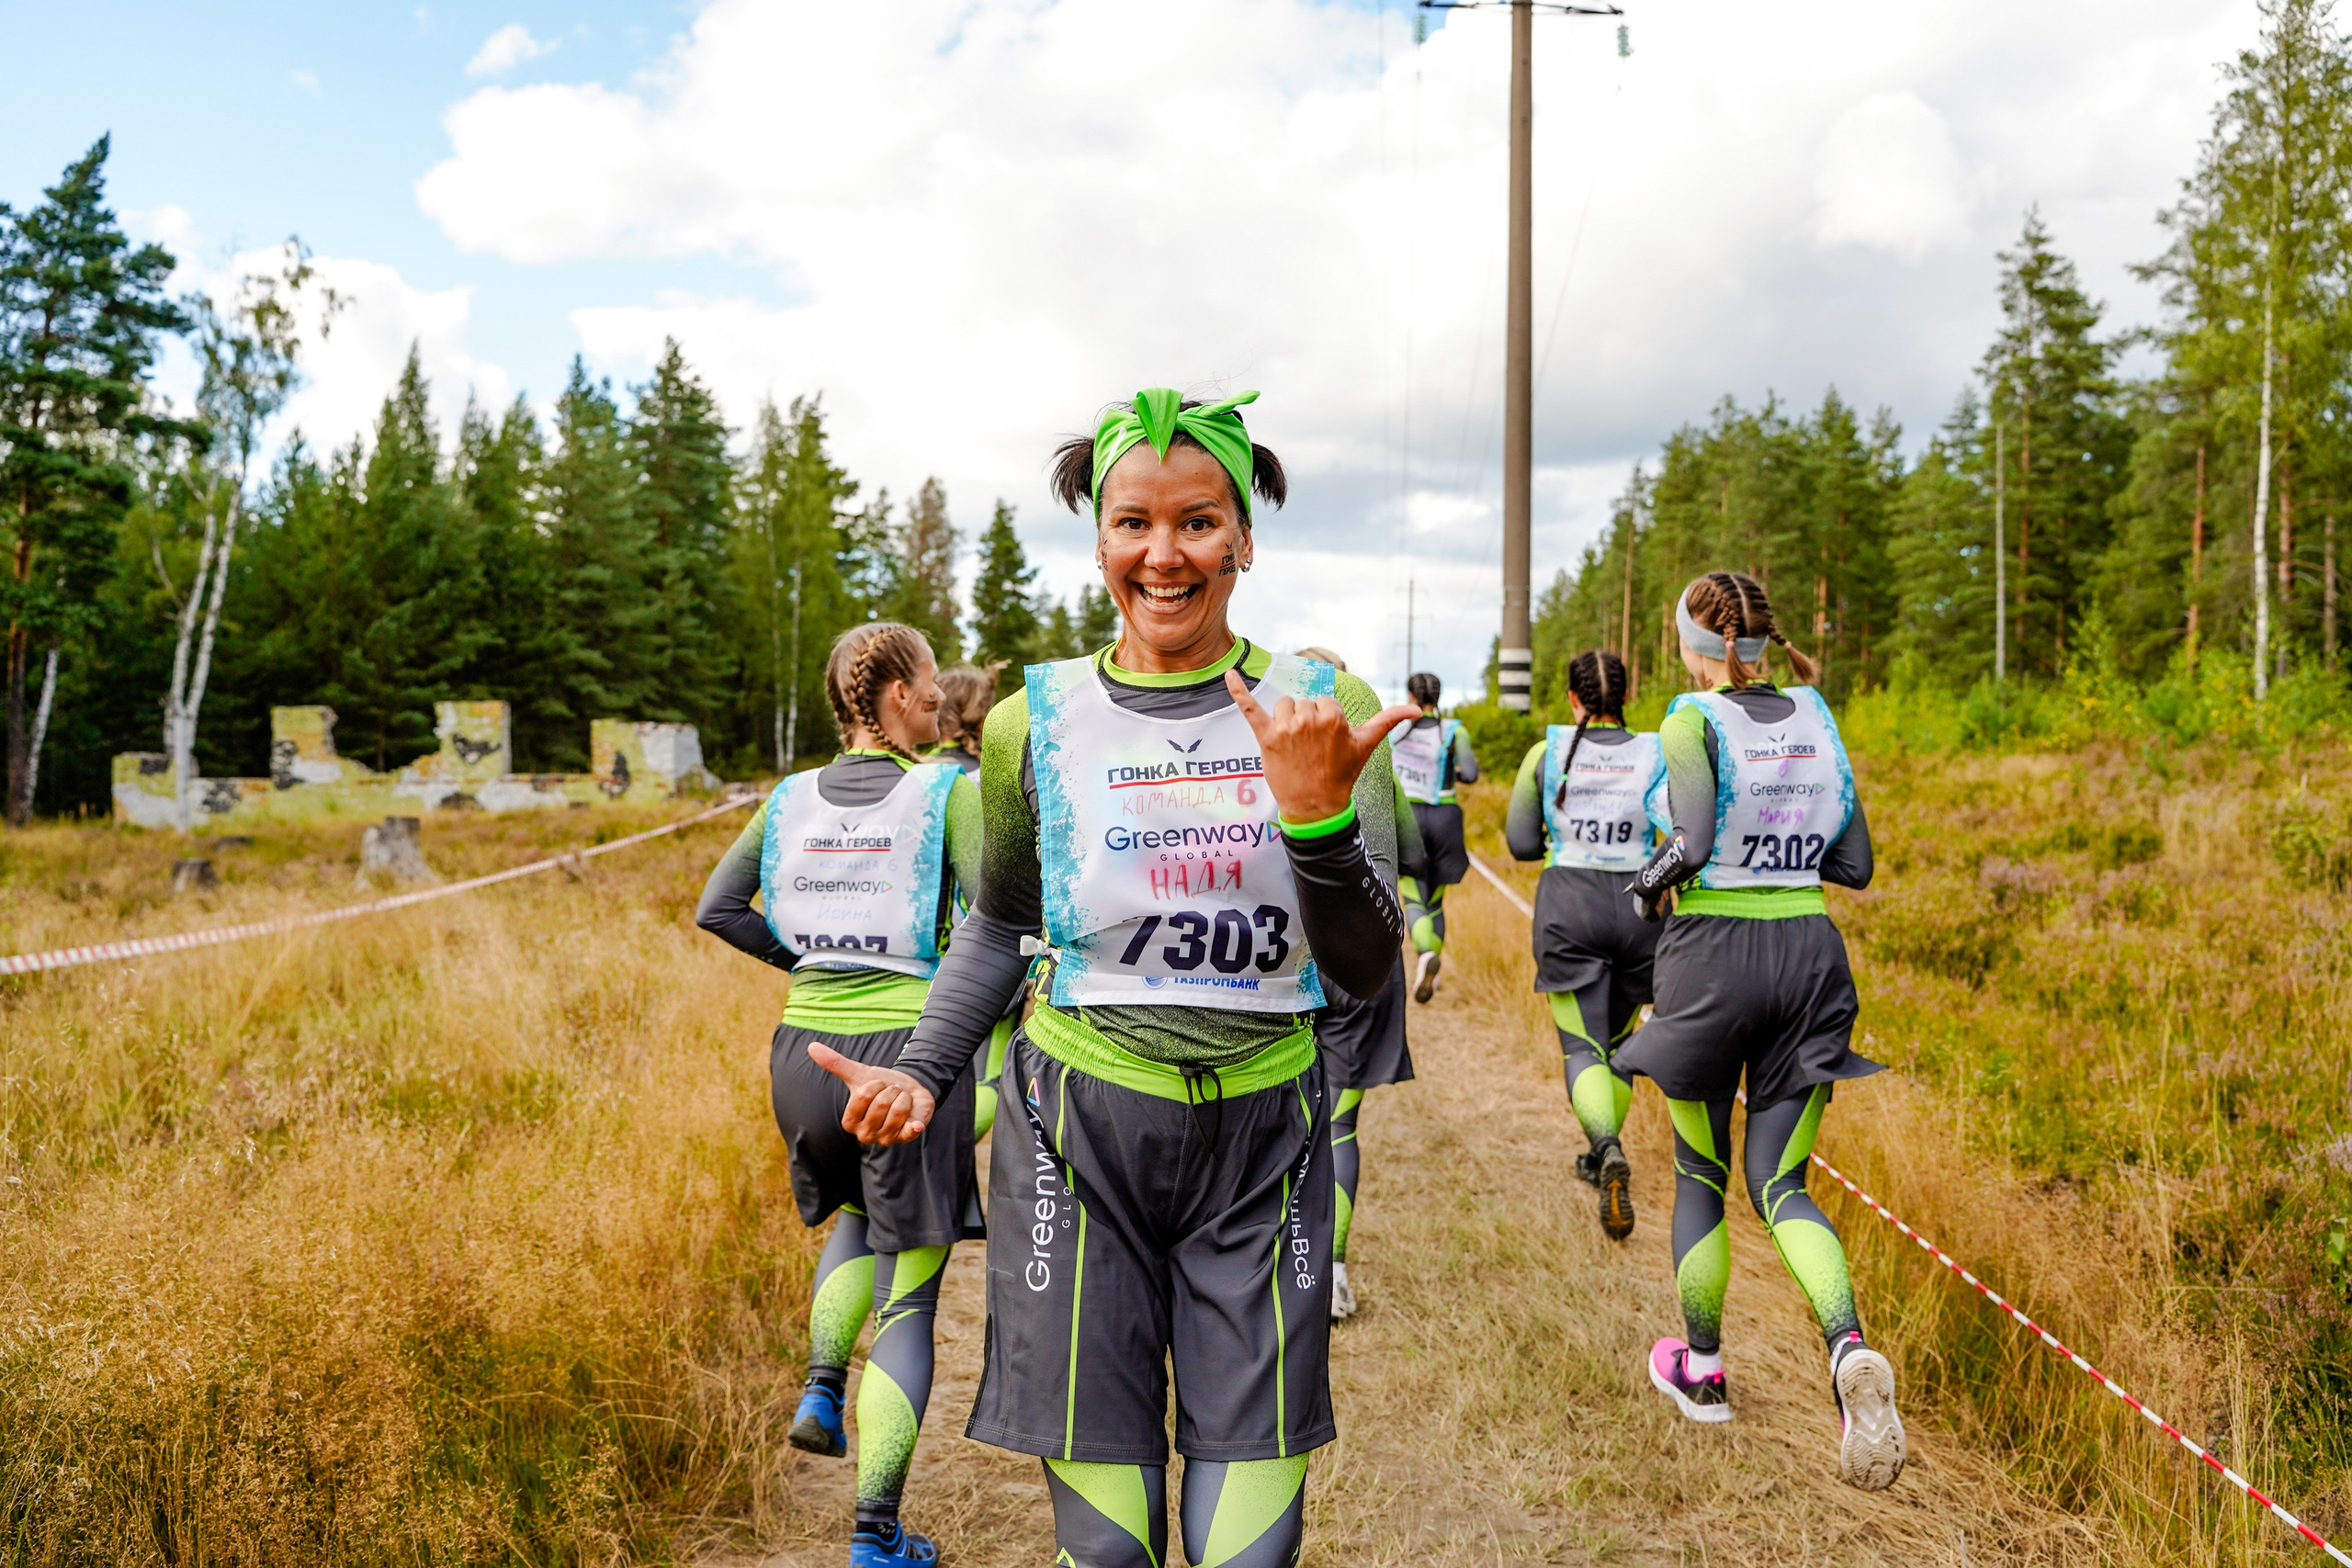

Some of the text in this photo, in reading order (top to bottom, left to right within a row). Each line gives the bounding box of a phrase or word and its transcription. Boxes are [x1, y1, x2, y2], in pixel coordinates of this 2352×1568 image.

[1745, 745, 1816, 759] ГОНКА ГЕРОЕВ
[1107, 761, 1180, 784] ГОНКА
[1122, 777, 1257, 818] КОМАНДА 6
[1750, 782, 1815, 798] Greenway
[803, 837, 892, 848] ГОНКА ГЕРОЕВ
[1104, 822, 1264, 852] Greenway
[1571, 818, 1634, 845] 7319
[1159, 850, 1234, 862] GLOBAL
[1739, 832, 1825, 870] 7302
[888, 858, 898, 872] 6
[794, 876, 881, 896] Greenway
[1150, 859, 1243, 901] НАДЯ
[1119, 904, 1290, 974] 7303
[1061, 1186, 1072, 1229] GLO
